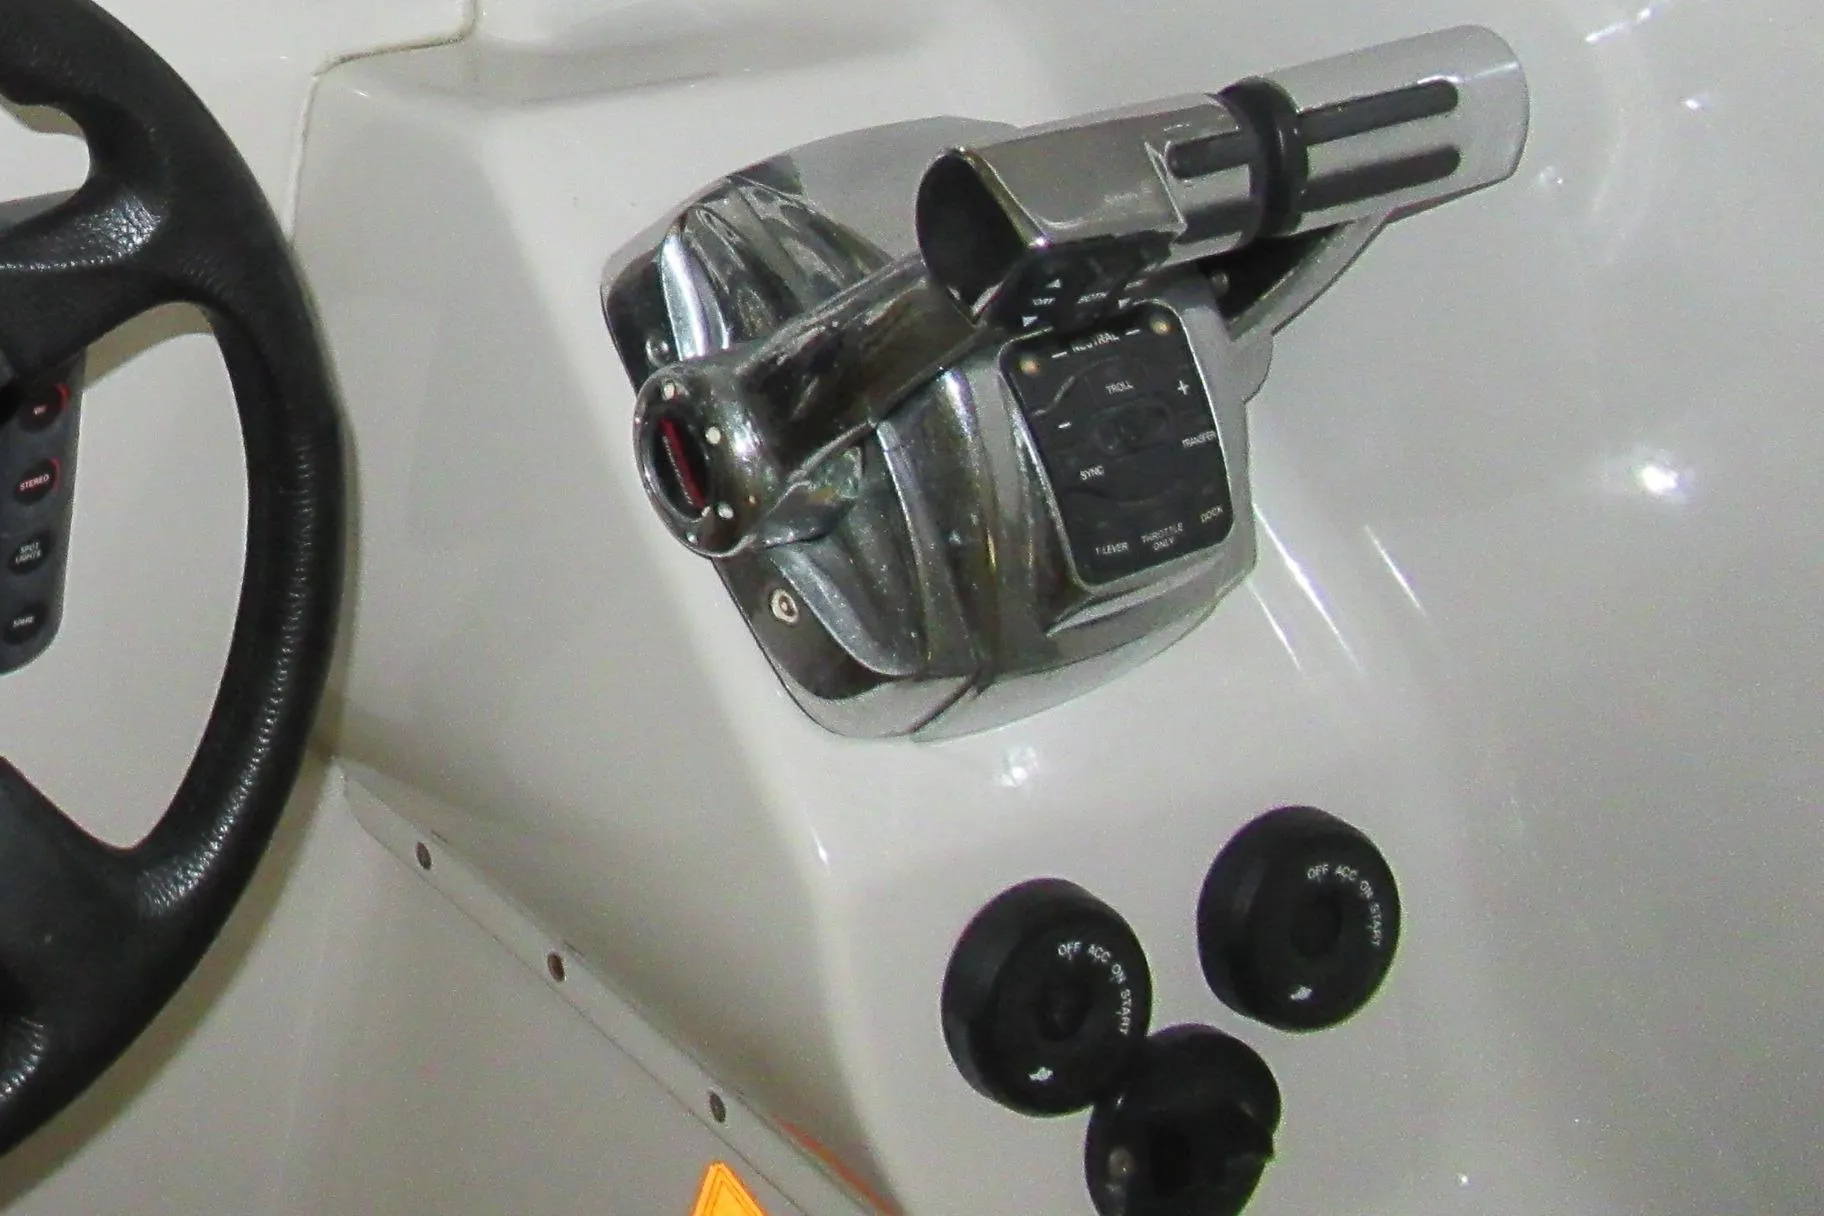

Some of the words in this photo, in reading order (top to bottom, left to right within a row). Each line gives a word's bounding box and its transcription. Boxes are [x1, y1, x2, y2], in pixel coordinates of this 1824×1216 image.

[1105, 381, 1133, 395] TROLL
[1181, 430, 1217, 448] TRANSFER
[19, 473, 50, 491] STEREO
[1080, 465, 1106, 481] SYNC
[1152, 538, 1175, 551] ONLY
[1307, 863, 1329, 880] OFF
[1334, 864, 1357, 882] ACC
[1359, 880, 1374, 898] ON
[1368, 903, 1382, 947] START
[1057, 941, 1082, 960] OFF
[1086, 943, 1112, 963] ACC
[1111, 963, 1127, 984] ON
[1118, 989, 1132, 1037] START
